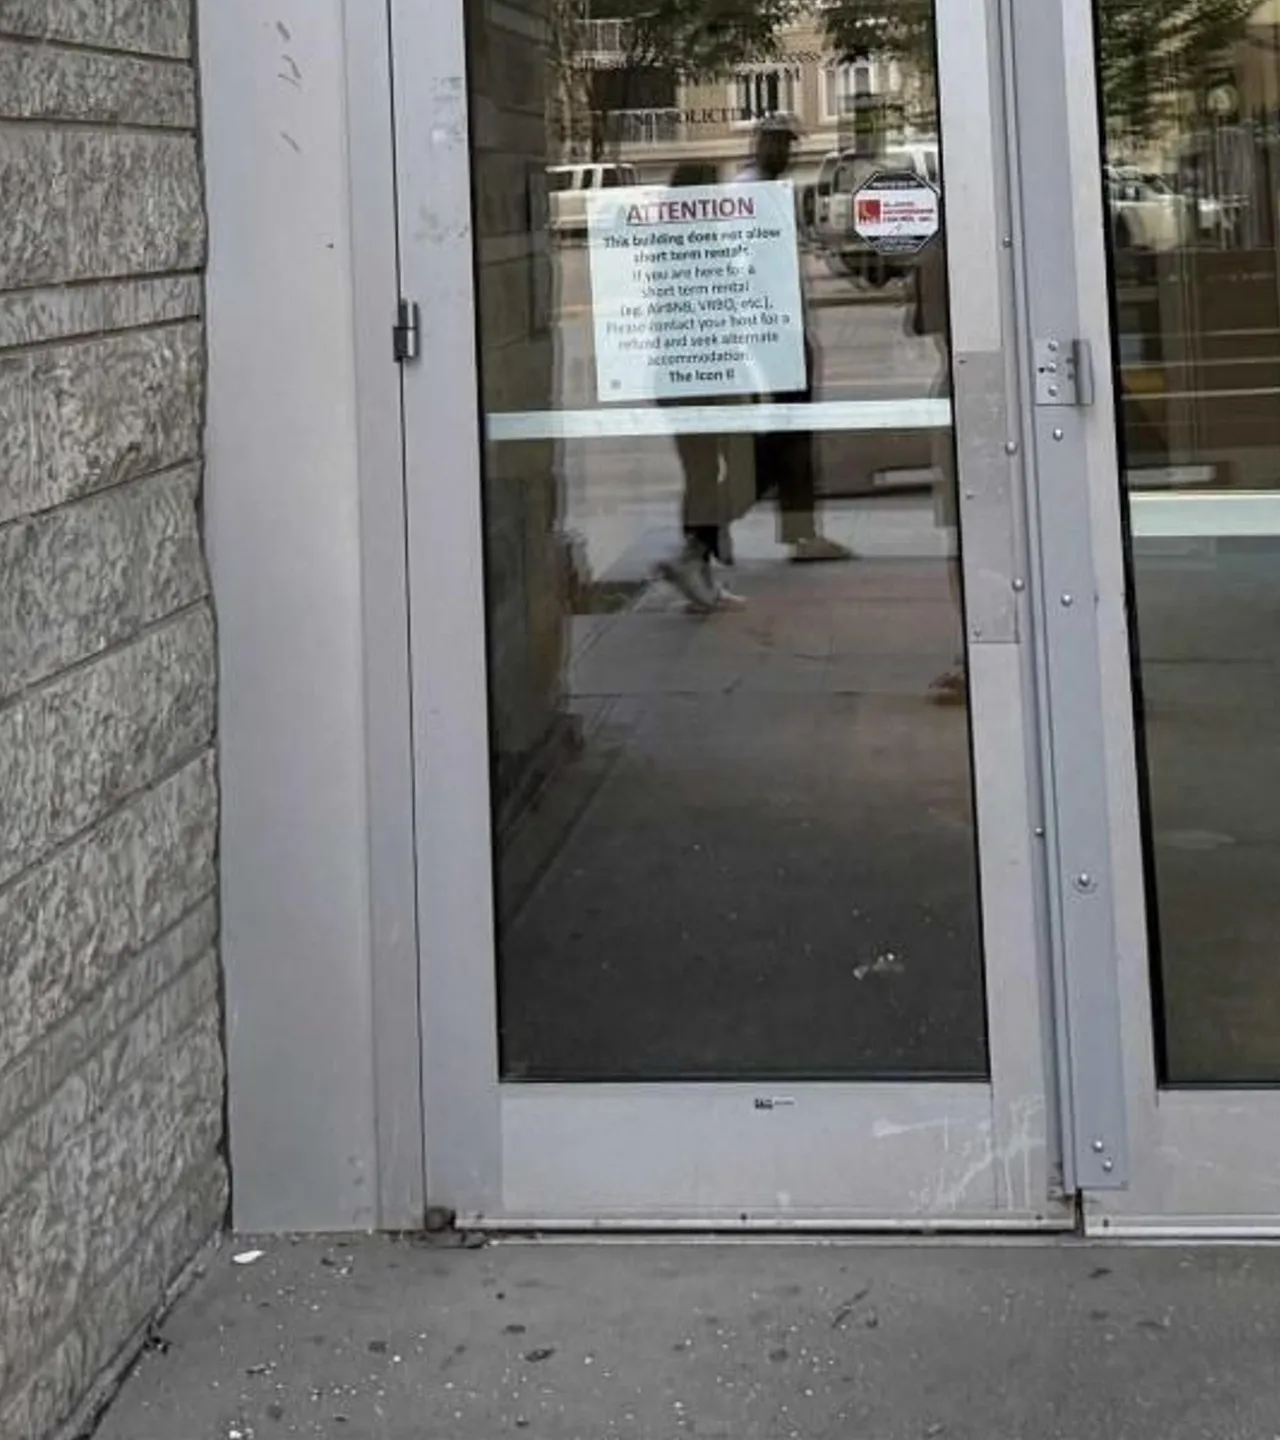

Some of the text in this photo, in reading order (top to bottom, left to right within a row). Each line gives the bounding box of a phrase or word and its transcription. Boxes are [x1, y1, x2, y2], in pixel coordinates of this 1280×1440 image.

[626, 197, 755, 223] ATTENTION
[603, 235, 630, 248] This
[632, 233, 685, 248] building
[687, 231, 718, 244] does
[746, 227, 781, 239] allow
[634, 250, 668, 263] short
[670, 249, 702, 261] term
[645, 270, 669, 282] you
[671, 268, 691, 279] are
[694, 265, 725, 278] here
[641, 281, 749, 299] short term rental
[649, 318, 695, 332] contact
[698, 318, 727, 332] your
[729, 314, 758, 327] host
[760, 313, 779, 326] for
[618, 331, 780, 350] refund and seek alternate
[669, 370, 693, 383] The
[694, 369, 723, 381] Icon
